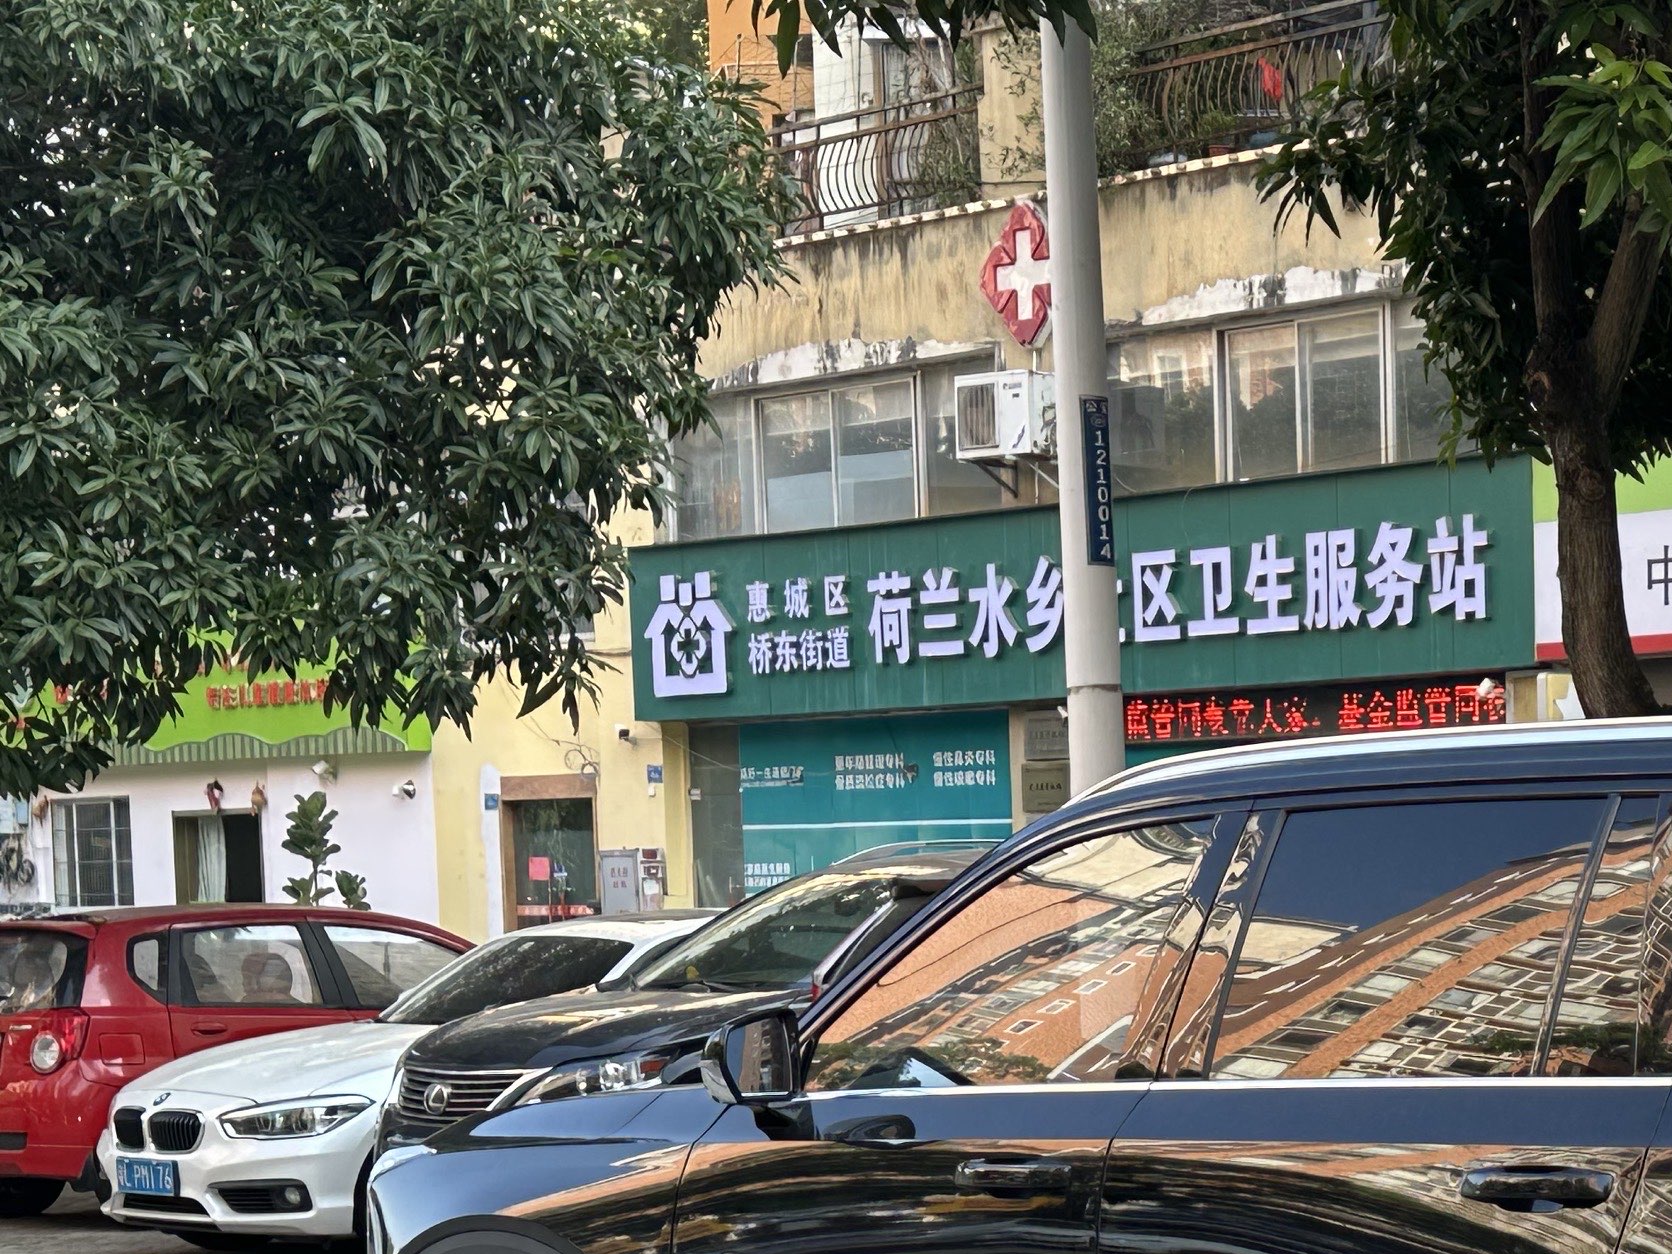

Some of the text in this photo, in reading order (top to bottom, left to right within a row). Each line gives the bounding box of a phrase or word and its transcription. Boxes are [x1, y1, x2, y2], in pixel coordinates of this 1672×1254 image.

[1094, 430, 1112, 560] 1210014
[745, 573, 850, 623] 惠城区
[866, 512, 1490, 664] 荷兰水乡区卫生服务站
[747, 626, 851, 675] 桥东街道
